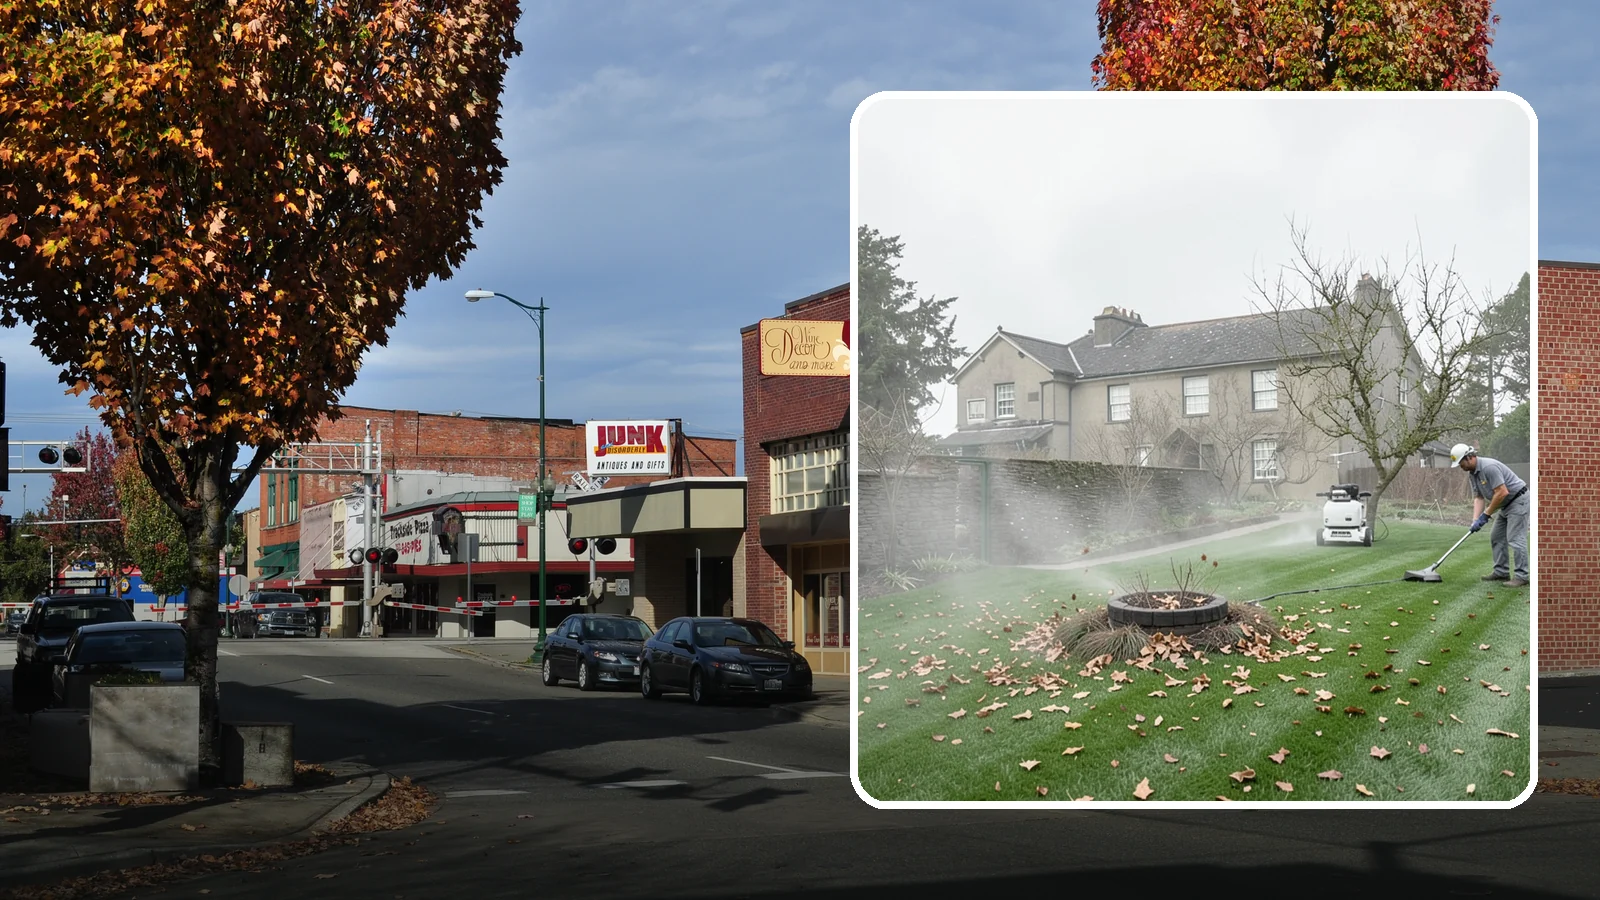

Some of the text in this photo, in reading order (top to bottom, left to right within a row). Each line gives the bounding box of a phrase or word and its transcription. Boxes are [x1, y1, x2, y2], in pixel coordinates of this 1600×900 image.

[595, 425, 665, 457] JUNK
[607, 446, 646, 454] DISORDERLY
[597, 461, 665, 470] ANTIQUES AND GIFTS
[414, 519, 429, 535] Pizza
